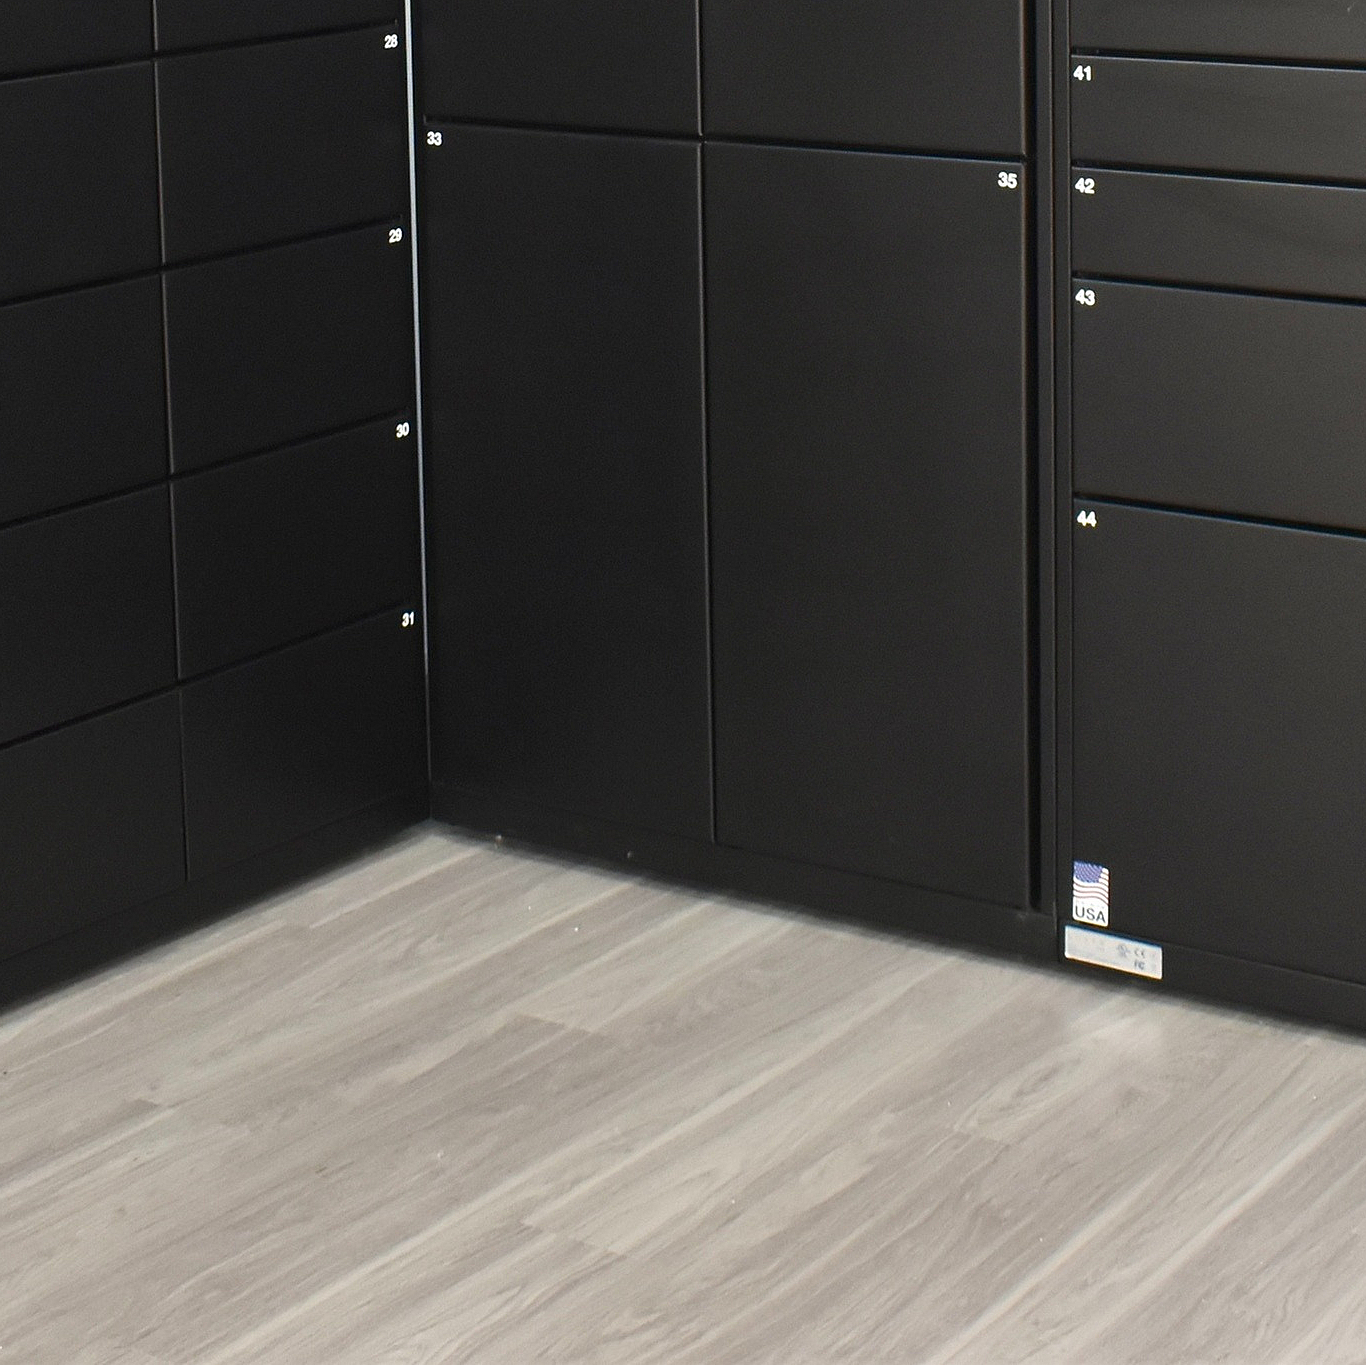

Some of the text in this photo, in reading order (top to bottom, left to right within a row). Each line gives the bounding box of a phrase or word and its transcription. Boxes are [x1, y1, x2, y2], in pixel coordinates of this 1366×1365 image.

[384, 33, 399, 49] 28
[1072, 64, 1092, 82] 41
[426, 130, 443, 147] 33
[997, 171, 1018, 189] 35
[1074, 177, 1096, 195] 42
[388, 227, 403, 244] 29
[1074, 288, 1096, 307] 43
[396, 421, 410, 439] 30
[1076, 510, 1098, 528] 44
[401, 611, 415, 628] 31
[1074, 905, 1107, 924] USA
